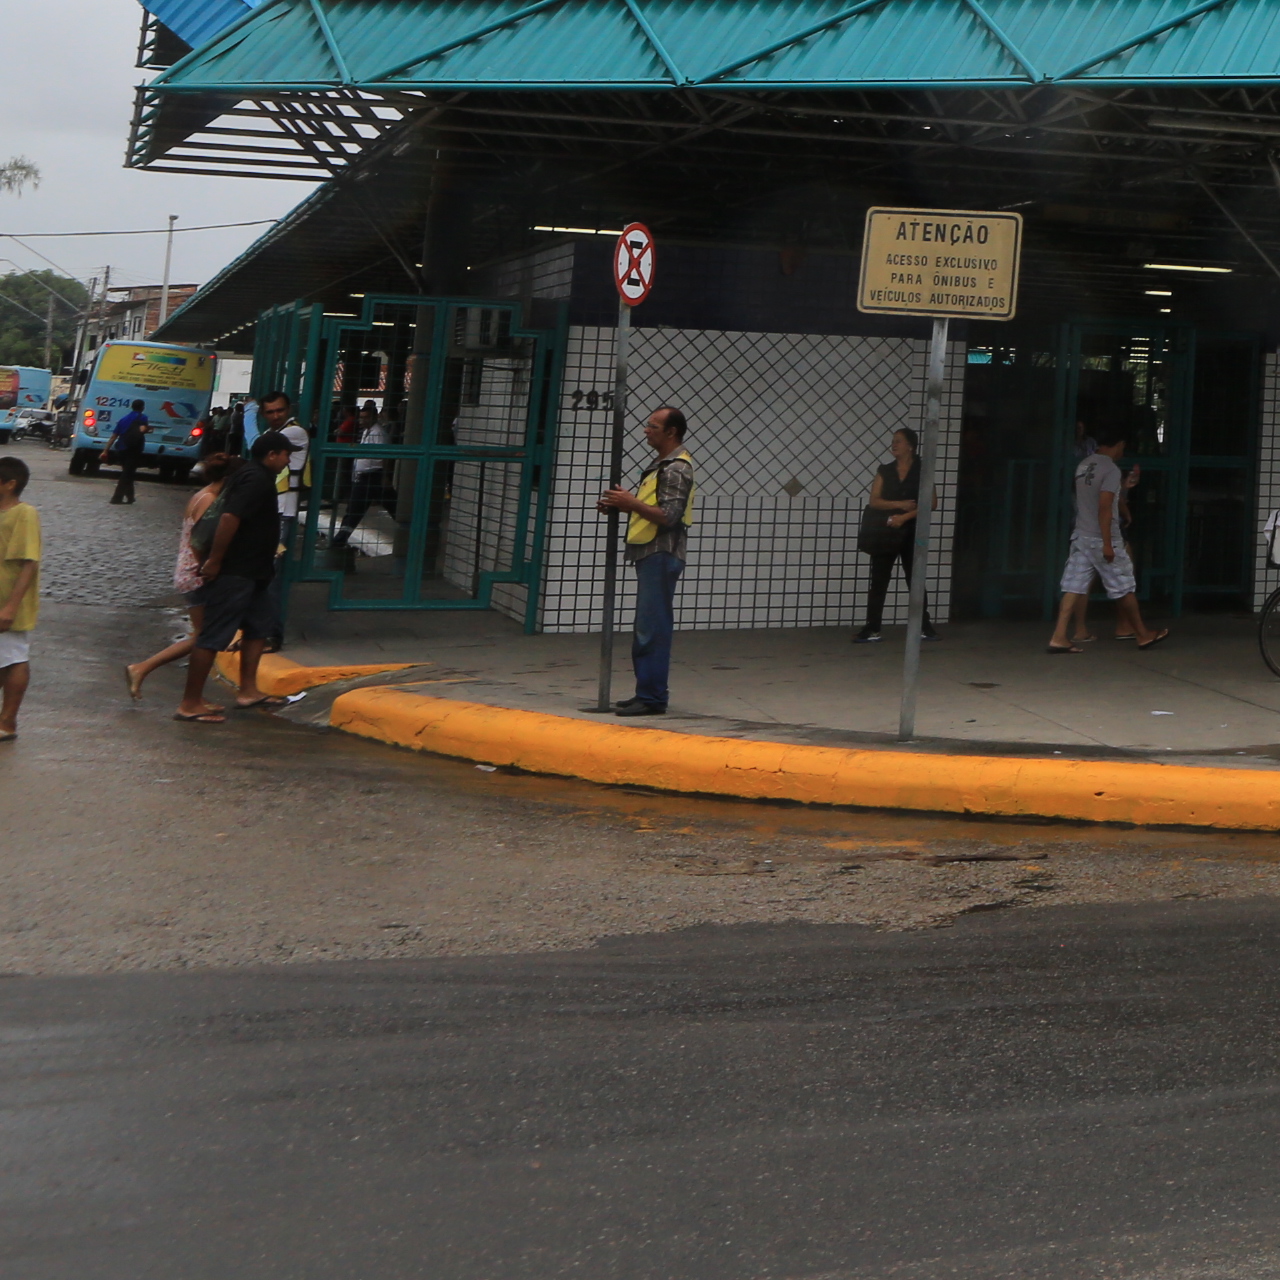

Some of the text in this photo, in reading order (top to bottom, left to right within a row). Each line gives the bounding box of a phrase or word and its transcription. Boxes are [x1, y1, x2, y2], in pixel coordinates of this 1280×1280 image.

[896, 220, 989, 246] ATENÇÃO
[886, 253, 998, 271] ACESSO EXCLUSIVO
[890, 271, 995, 289] PARA ÔNIBUS E
[870, 287, 1006, 309] VEÍCULOS AUTORIZADOS
[95, 396, 130, 408] 12214
